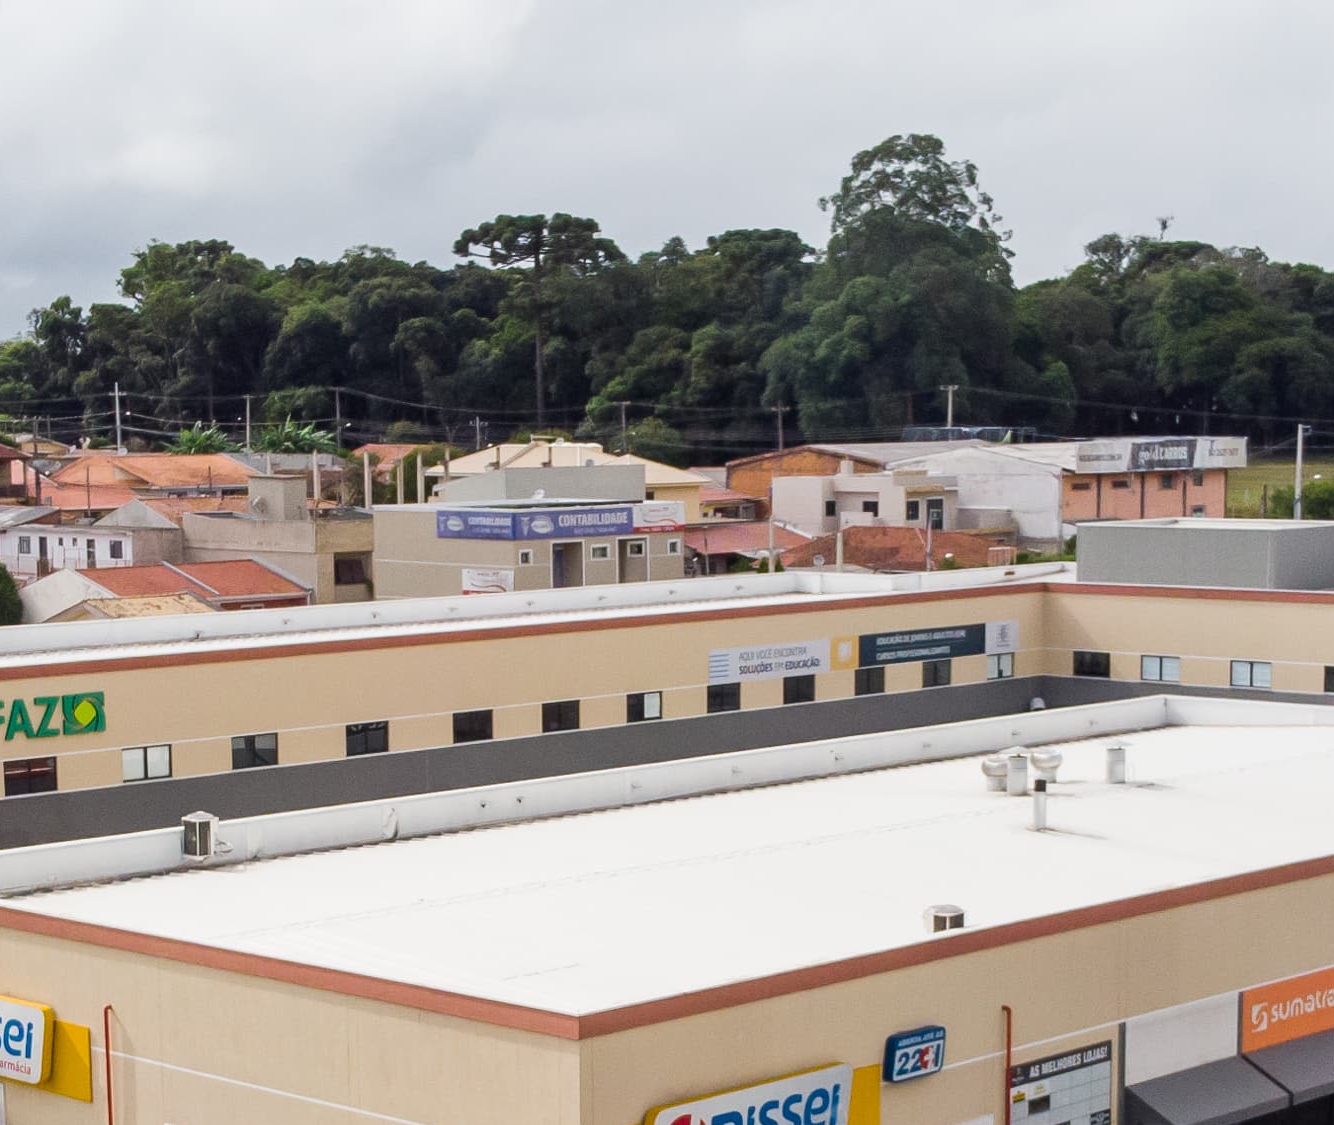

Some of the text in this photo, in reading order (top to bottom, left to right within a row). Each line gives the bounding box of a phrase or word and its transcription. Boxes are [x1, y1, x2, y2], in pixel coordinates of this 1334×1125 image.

[558, 511, 628, 527] CONTABILIDADE
[739, 661, 772, 675] SOLUÇÕES
[1029, 1045, 1108, 1079] AS MELHORES LOJAS!
